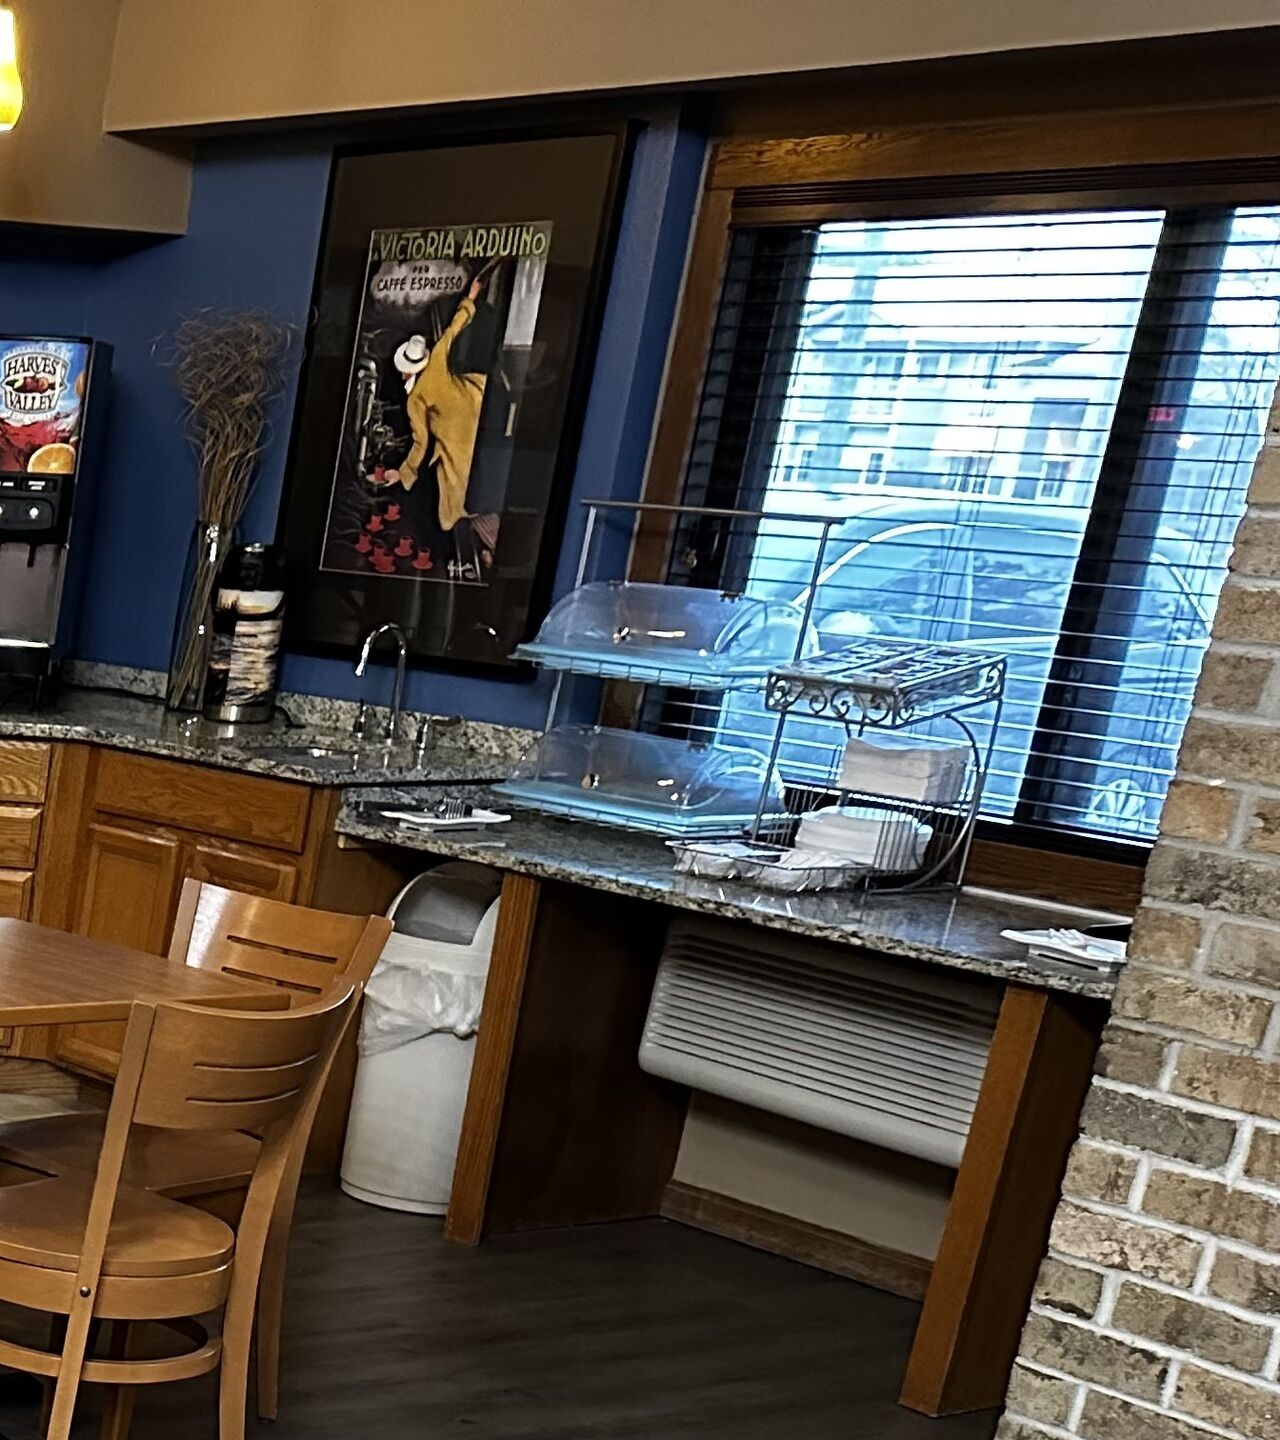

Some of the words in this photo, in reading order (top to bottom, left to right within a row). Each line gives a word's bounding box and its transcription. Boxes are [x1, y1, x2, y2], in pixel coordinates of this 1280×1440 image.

[380, 230, 455, 261] VICTORIA
[460, 226, 547, 258] ARDUINO
[410, 276, 463, 292] ESPRESSO
[7, 355, 62, 378] HARVES
[8, 390, 56, 411] VALLEY
